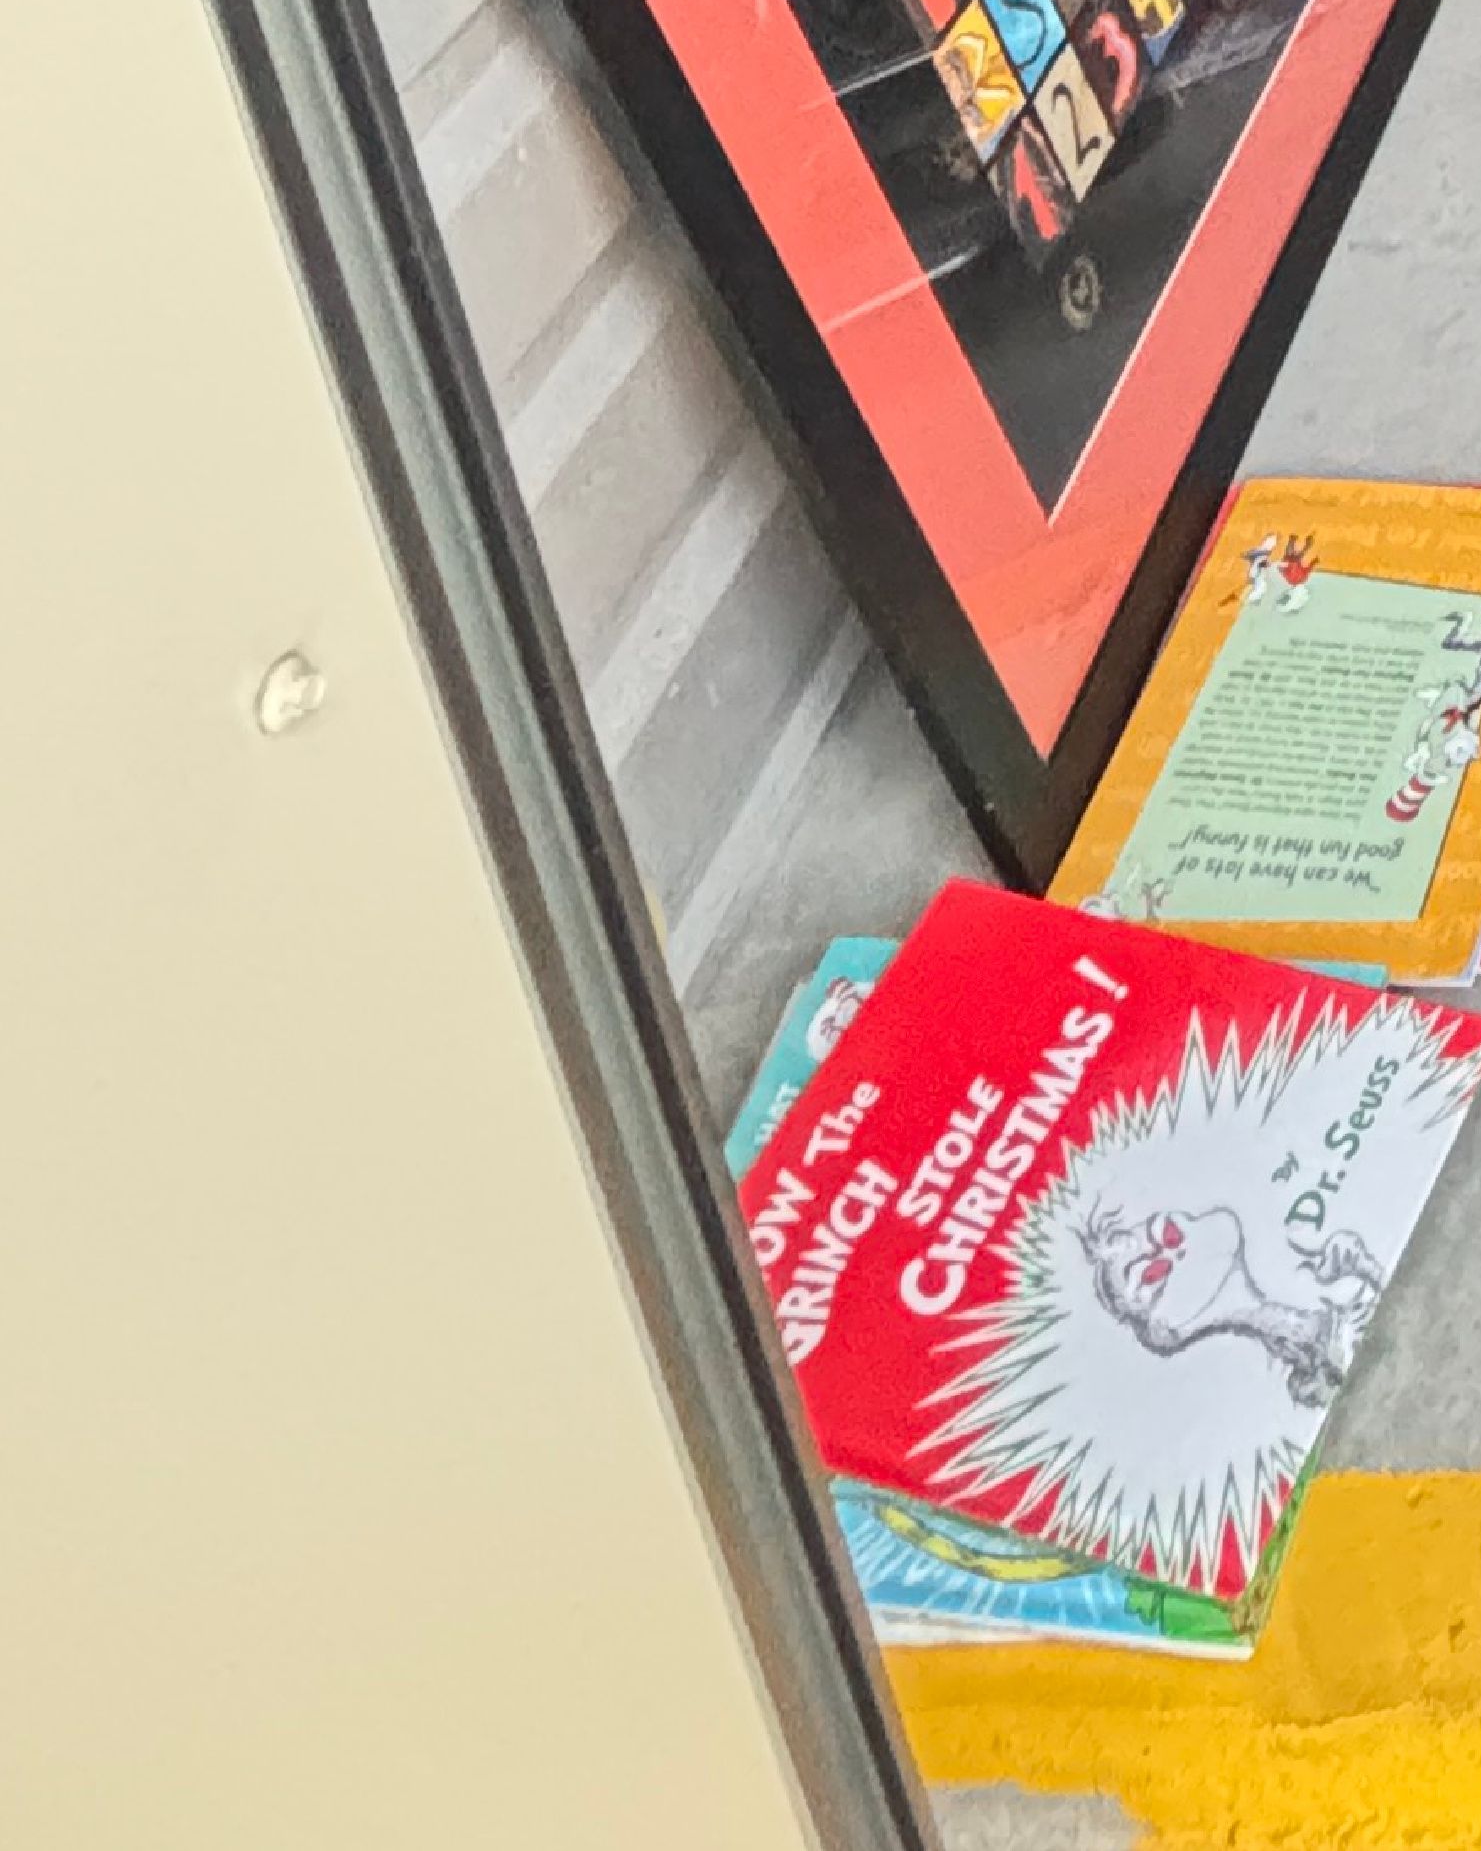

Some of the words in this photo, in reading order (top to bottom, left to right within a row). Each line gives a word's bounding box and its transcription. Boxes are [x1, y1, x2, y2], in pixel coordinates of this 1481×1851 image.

[1012, 136, 1060, 241] 1
[1051, 81, 1101, 166] 2
[1090, 12, 1140, 114] 3
[1253, 834, 1270, 856] is
[1272, 836, 1313, 861] that
[1320, 838, 1351, 862] fun
[1355, 836, 1405, 862] good
[1172, 855, 1199, 876] of
[1204, 856, 1244, 883] lots
[1250, 861, 1297, 889] have
[1303, 865, 1339, 881] can
[898, 1075, 1004, 1227] STOLE
[1284, 1169, 1346, 1232] Dr.
[1325, 1054, 1400, 1162] Seuss
[749, 1166, 817, 1269] OW
[803, 1081, 882, 1169] The
